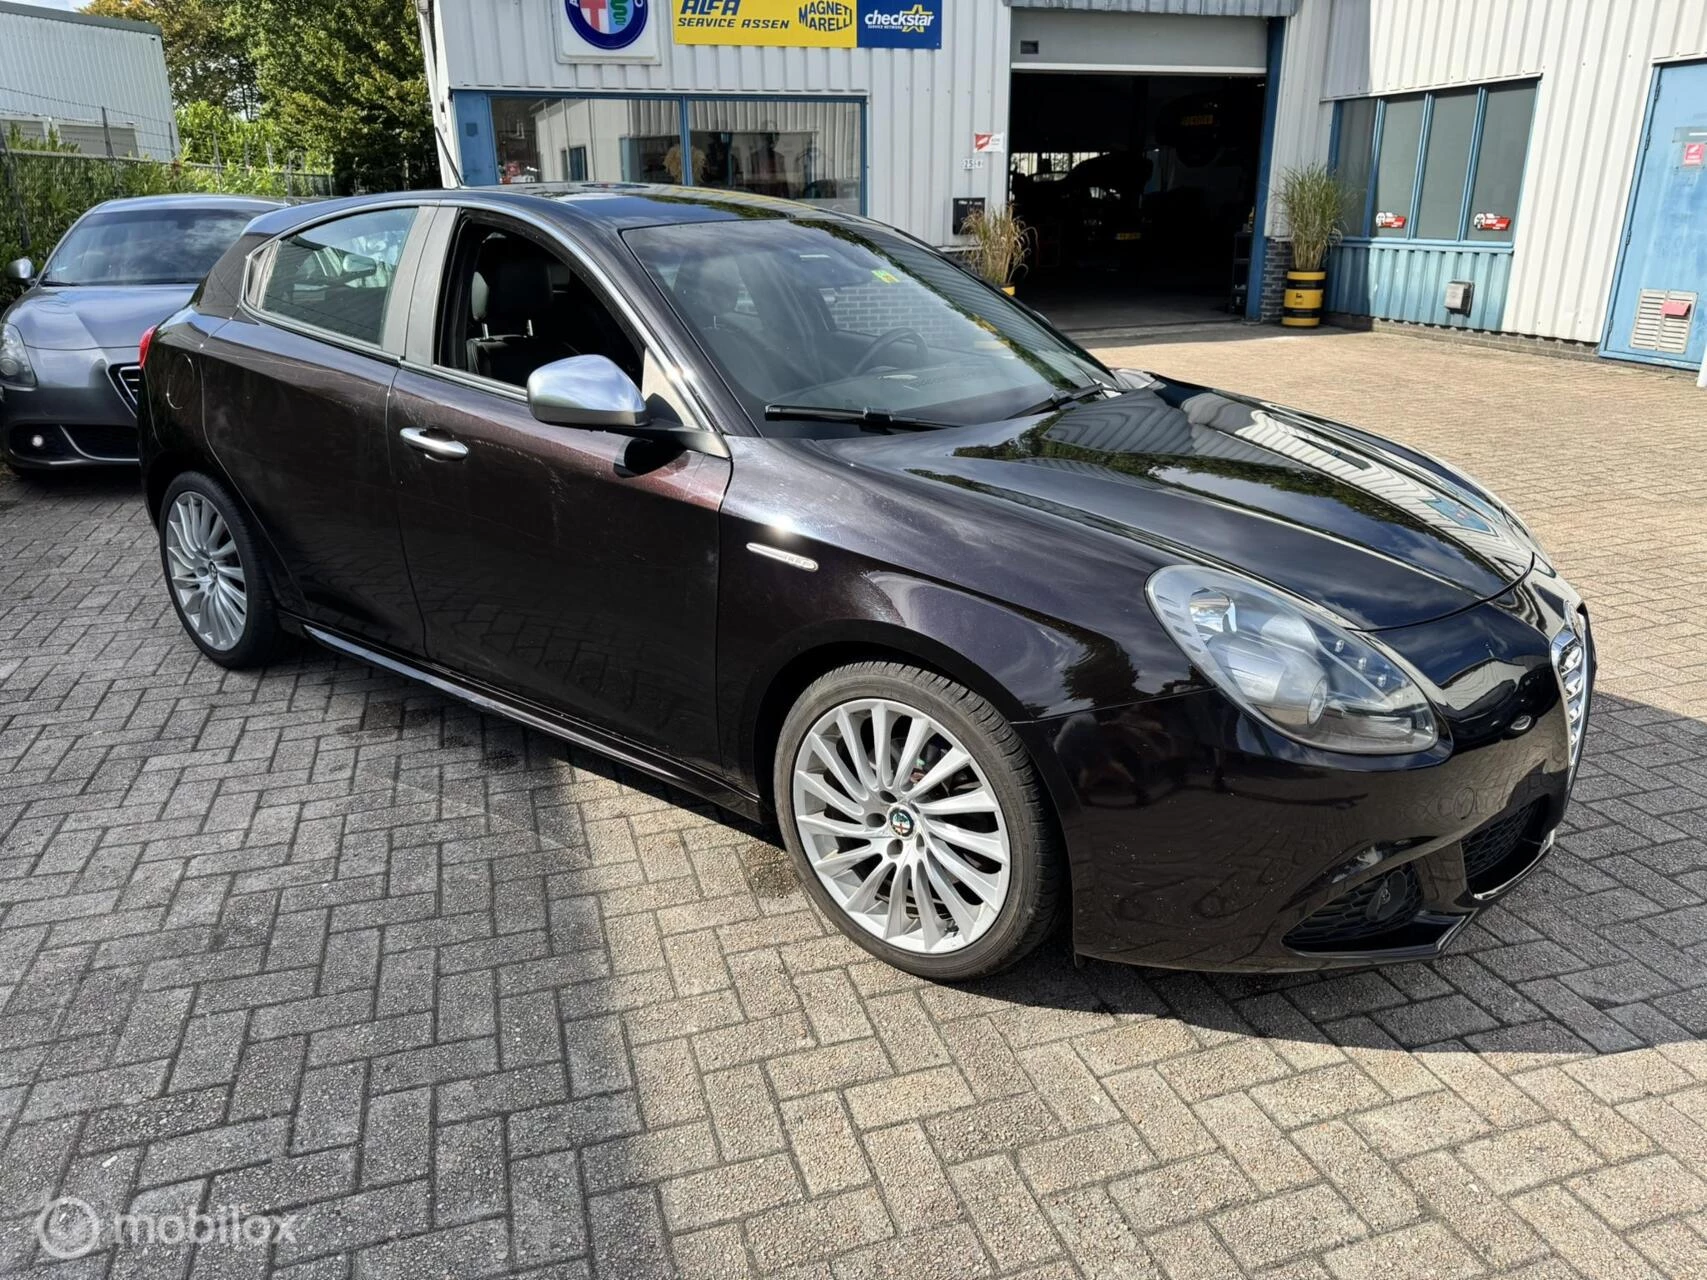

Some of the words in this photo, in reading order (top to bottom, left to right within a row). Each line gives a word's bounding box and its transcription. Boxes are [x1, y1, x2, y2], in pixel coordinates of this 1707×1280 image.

[680, 0, 740, 15] ALFA
[678, 18, 736, 28] SERVICE
[741, 19, 789, 29] ASSEN
[865, 10, 934, 26] checkstar
